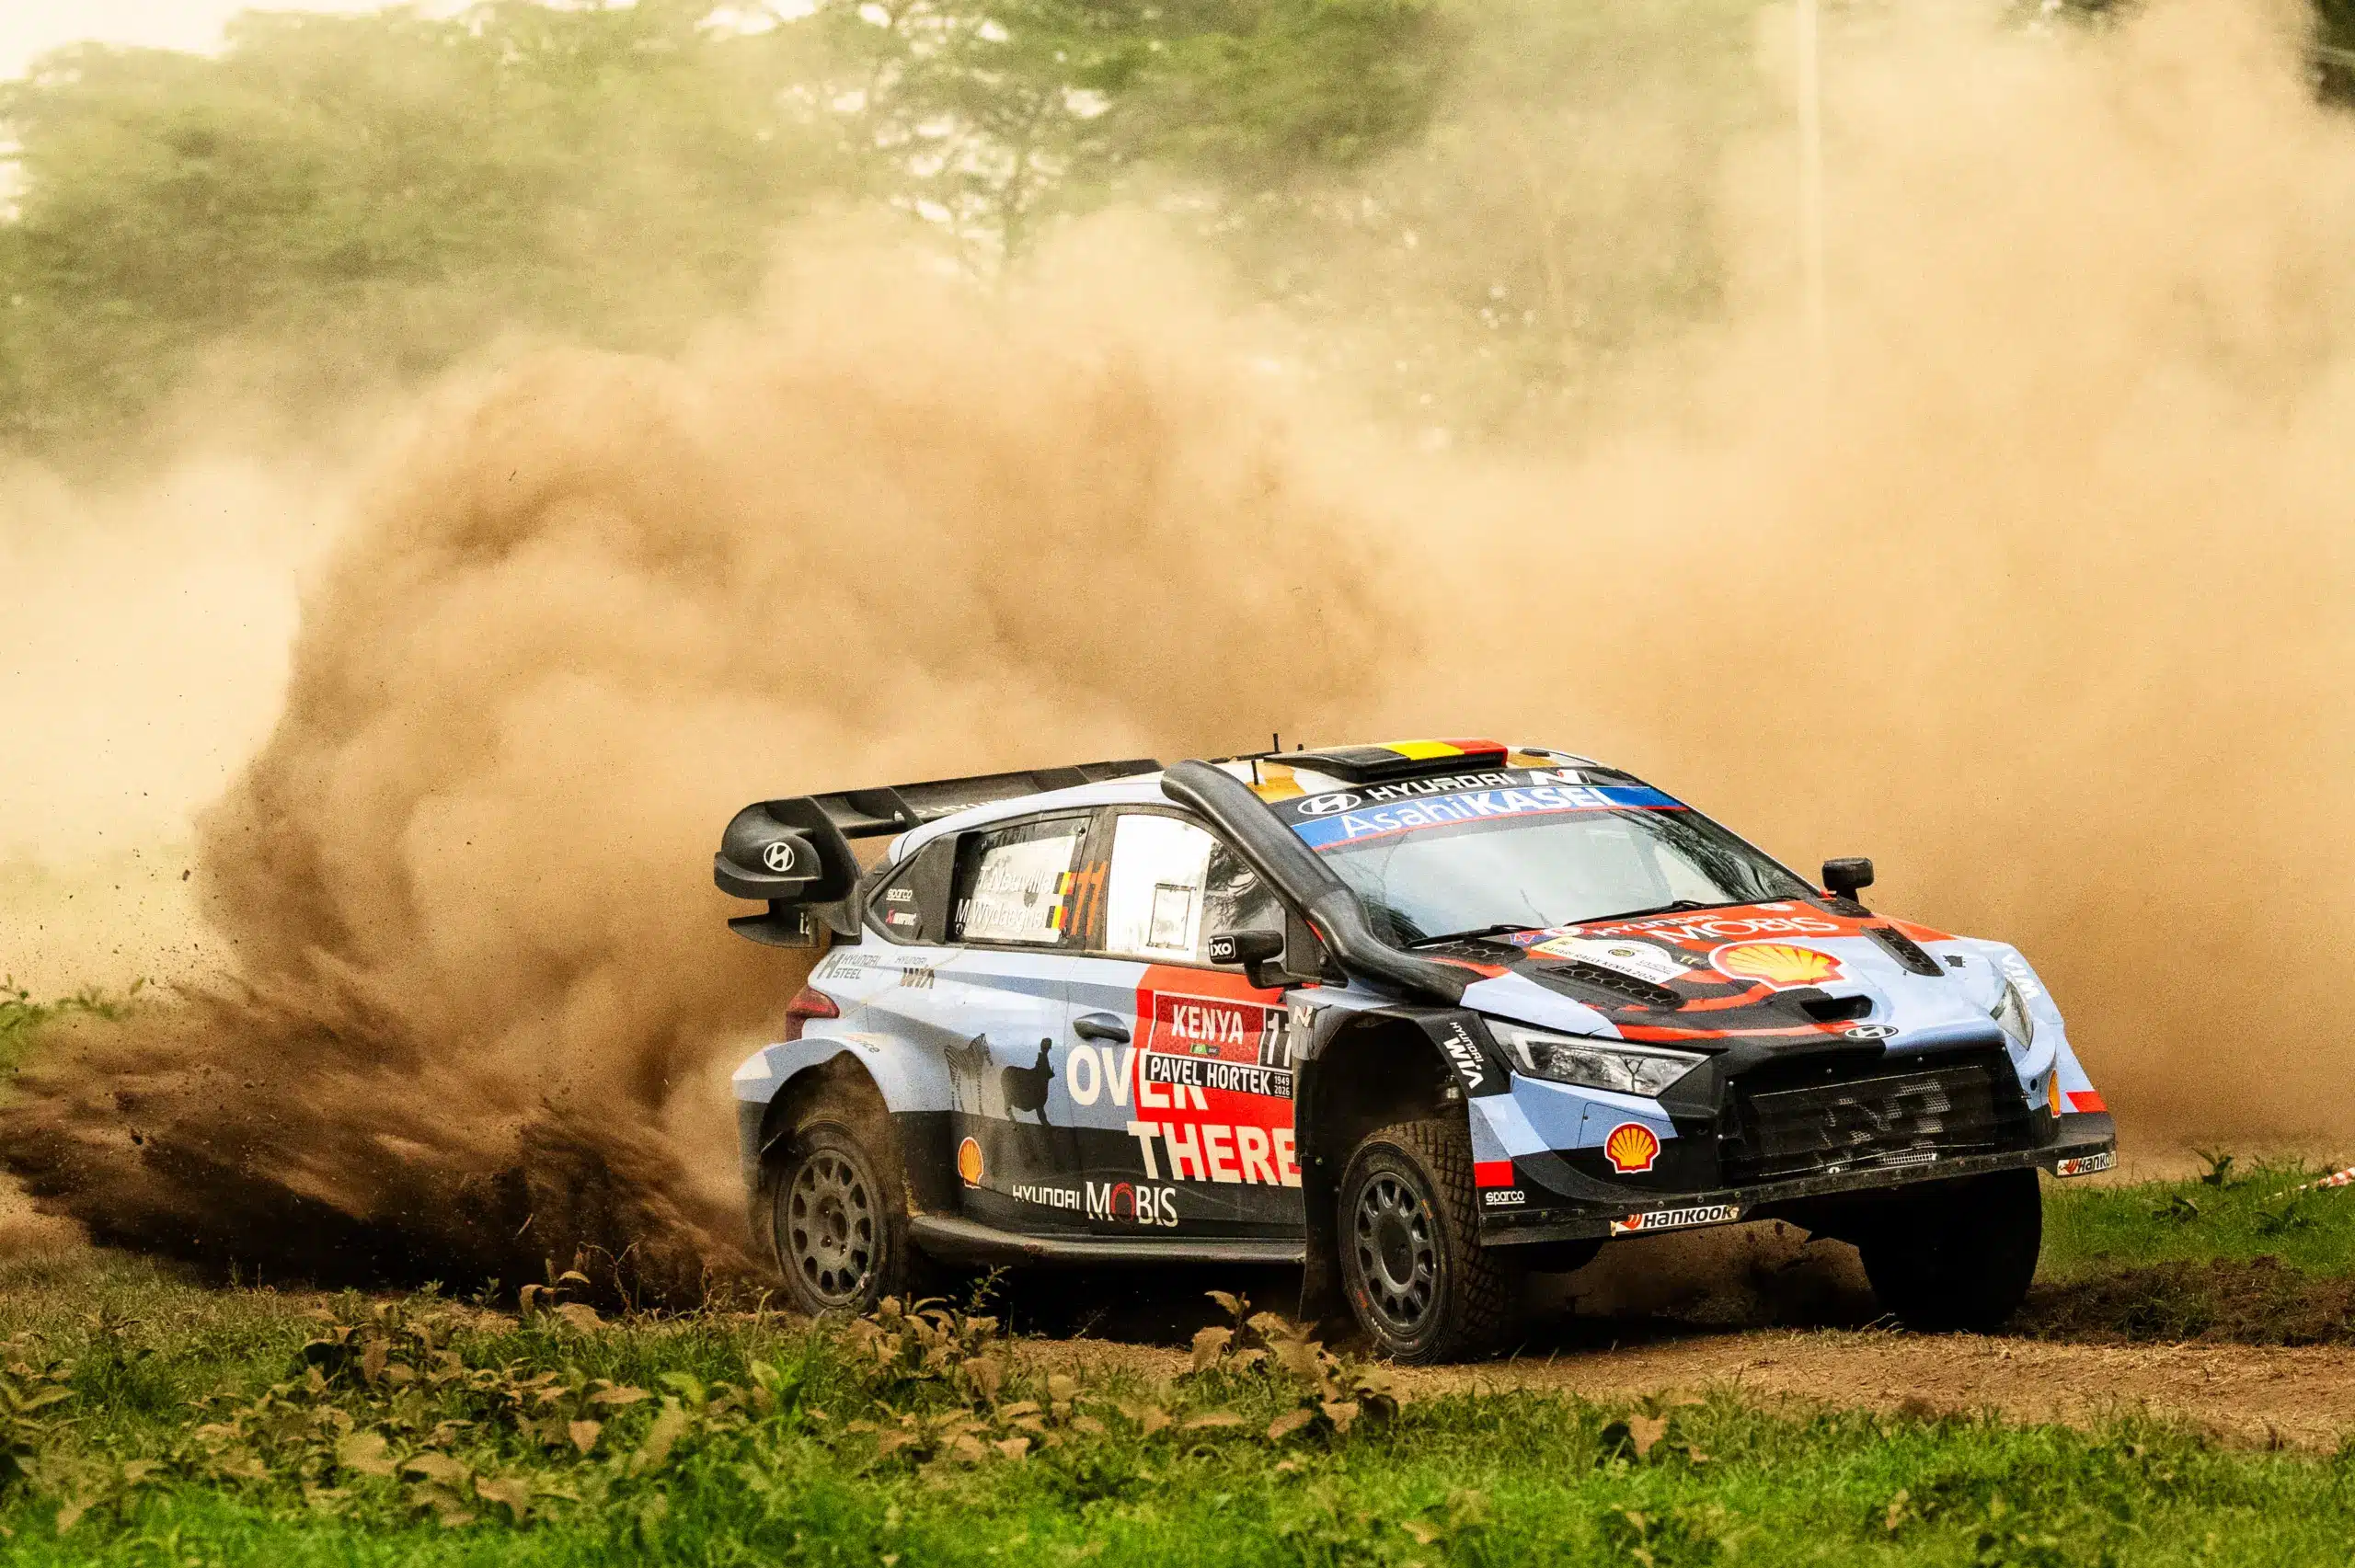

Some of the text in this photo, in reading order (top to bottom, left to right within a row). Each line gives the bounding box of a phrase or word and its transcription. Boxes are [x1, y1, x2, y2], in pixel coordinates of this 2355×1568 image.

[1366, 773, 1517, 801] HYUNDAI
[886, 888, 913, 902] sparco
[1070, 860, 1109, 936] 11
[1591, 914, 1723, 936] HYUNDAI
[1645, 917, 1839, 943] MOBIS
[841, 953, 882, 966] HYUNDAI
[833, 967, 862, 979] STEEL
[1632, 970, 1656, 981] 2026
[1171, 1004, 1244, 1044] KENYA
[1449, 1022, 1484, 1062] HYUNDAI
[1150, 1057, 1271, 1095] PAVEL HORTEK
[1443, 1037, 1484, 1089] WIA
[1274, 1075, 1290, 1086] 1949
[1274, 1085, 1291, 1096] 2026
[1126, 1119, 1303, 1188] THERE
[1012, 1180, 1178, 1228] HYUNDAI MOBIS
[1486, 1190, 1525, 1205] sparco
